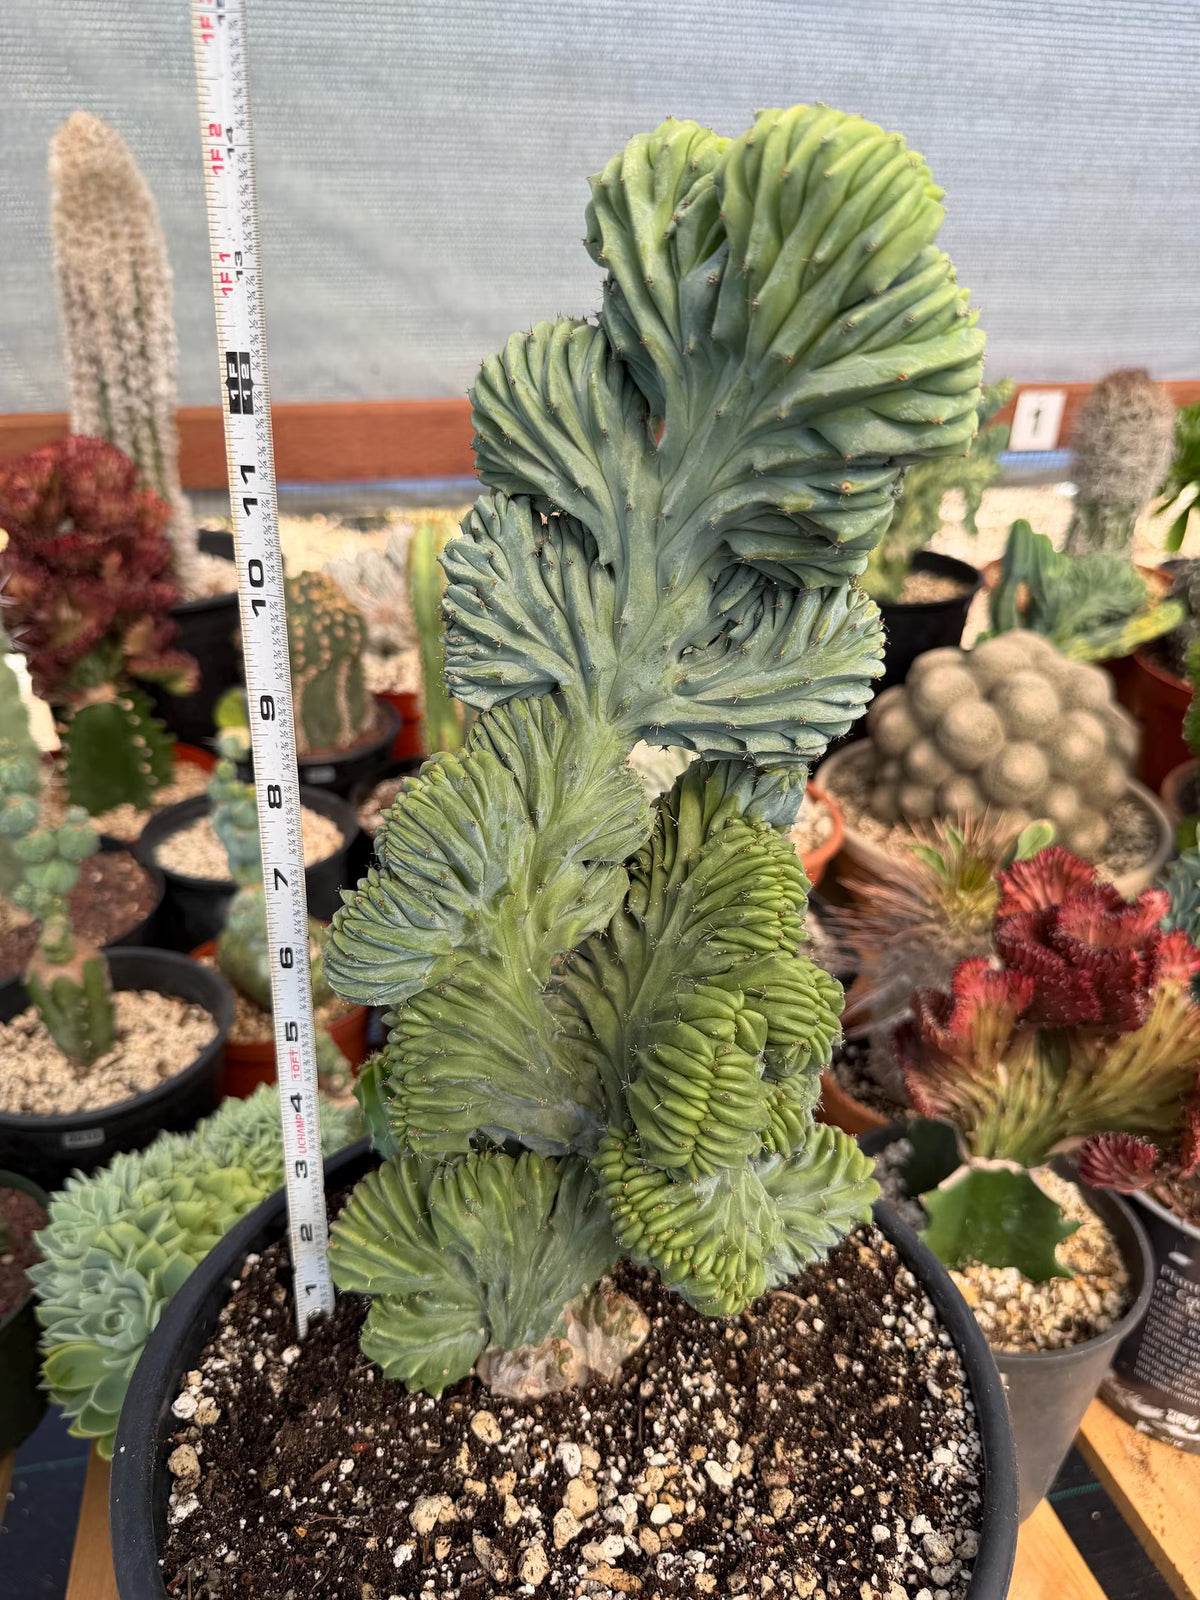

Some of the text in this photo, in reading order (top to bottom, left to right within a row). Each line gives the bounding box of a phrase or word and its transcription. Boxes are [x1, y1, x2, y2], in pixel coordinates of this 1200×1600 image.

[226, 127, 235, 159] 14
[210, 148, 225, 175] 1F
[234, 250, 244, 281] 13
[220, 272, 233, 296] 1F
[228, 363, 240, 400] 1F
[241, 363, 251, 400] 12
[240, 465, 258, 517] 11
[248, 559, 267, 617] 10
[260, 695, 275, 721] 9
[267, 785, 282, 809] 8
[274, 868, 288, 890] 7
[280, 947, 293, 969] 6
[285, 1021, 298, 1042] 5
[290, 1050, 301, 1079] 10FT
[290, 1092, 302, 1113] 4
[295, 1160, 307, 1179] 3
[300, 1224, 312, 1241] 2
[305, 1284, 317, 1296] 1
